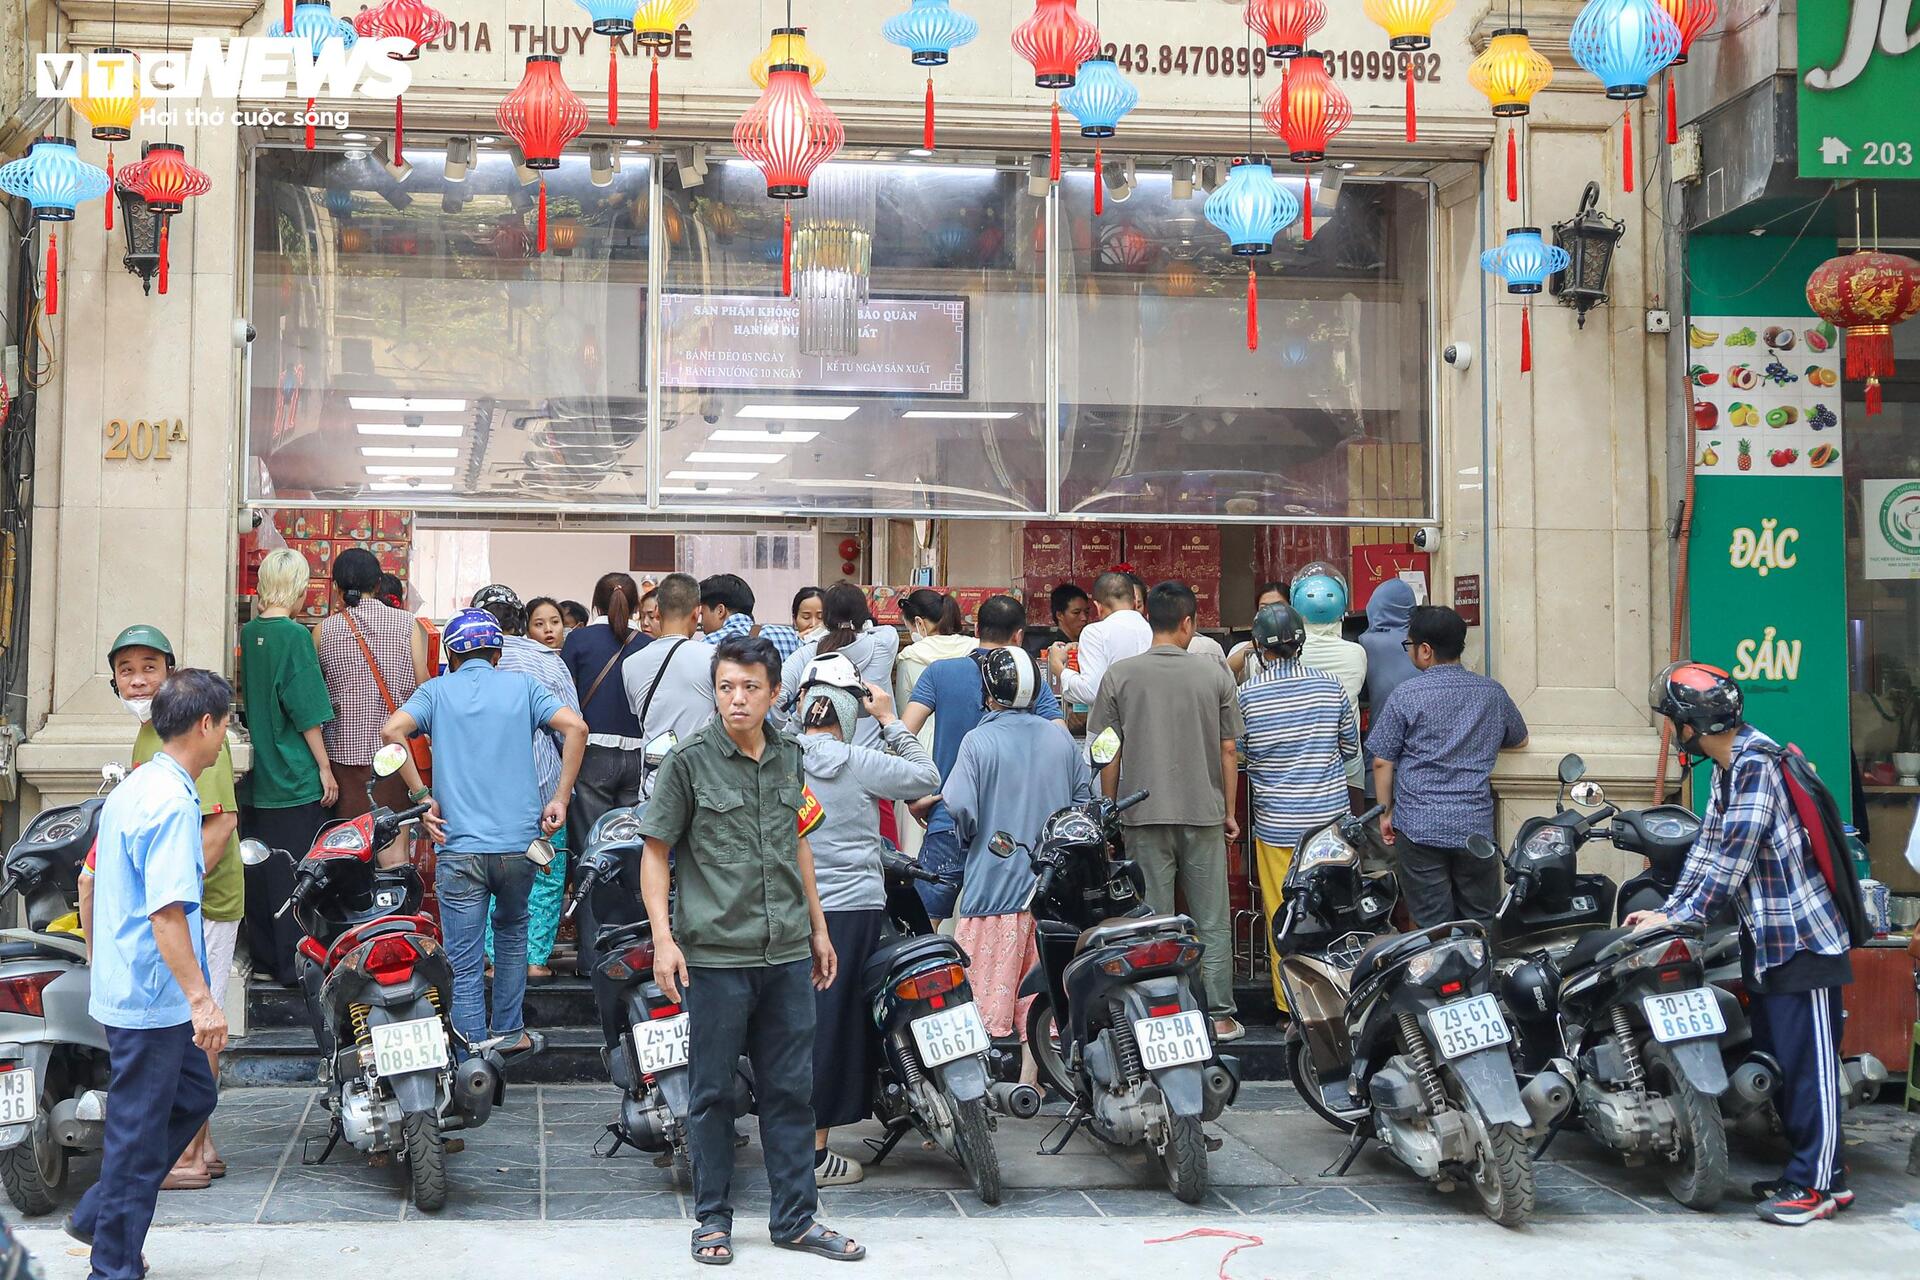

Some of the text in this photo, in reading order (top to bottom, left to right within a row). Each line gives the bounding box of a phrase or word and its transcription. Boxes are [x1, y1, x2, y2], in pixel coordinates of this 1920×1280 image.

[1099, 43, 1266, 76] 243.8470899
[1863, 142, 1913, 165] 203
[742, 353, 752, 361] 05
[104, 418, 187, 461] 201A
[1729, 518, 1799, 577] ĐẶC
[1732, 626, 1802, 680] SẢN
[1440, 999, 1490, 1031] 29-G1
[1656, 992, 1707, 1017] 30-L3
[384, 1022, 432, 1049] 29-B1
[1145, 1015, 1194, 1043] 29-BA
[1444, 1020, 1504, 1054] 355.29
[1663, 1012, 1714, 1037] 8669
[380, 1043, 443, 1072] 089.54
[929, 1029, 976, 1061] 0667
[1145, 1036, 1205, 1065] 069.01
